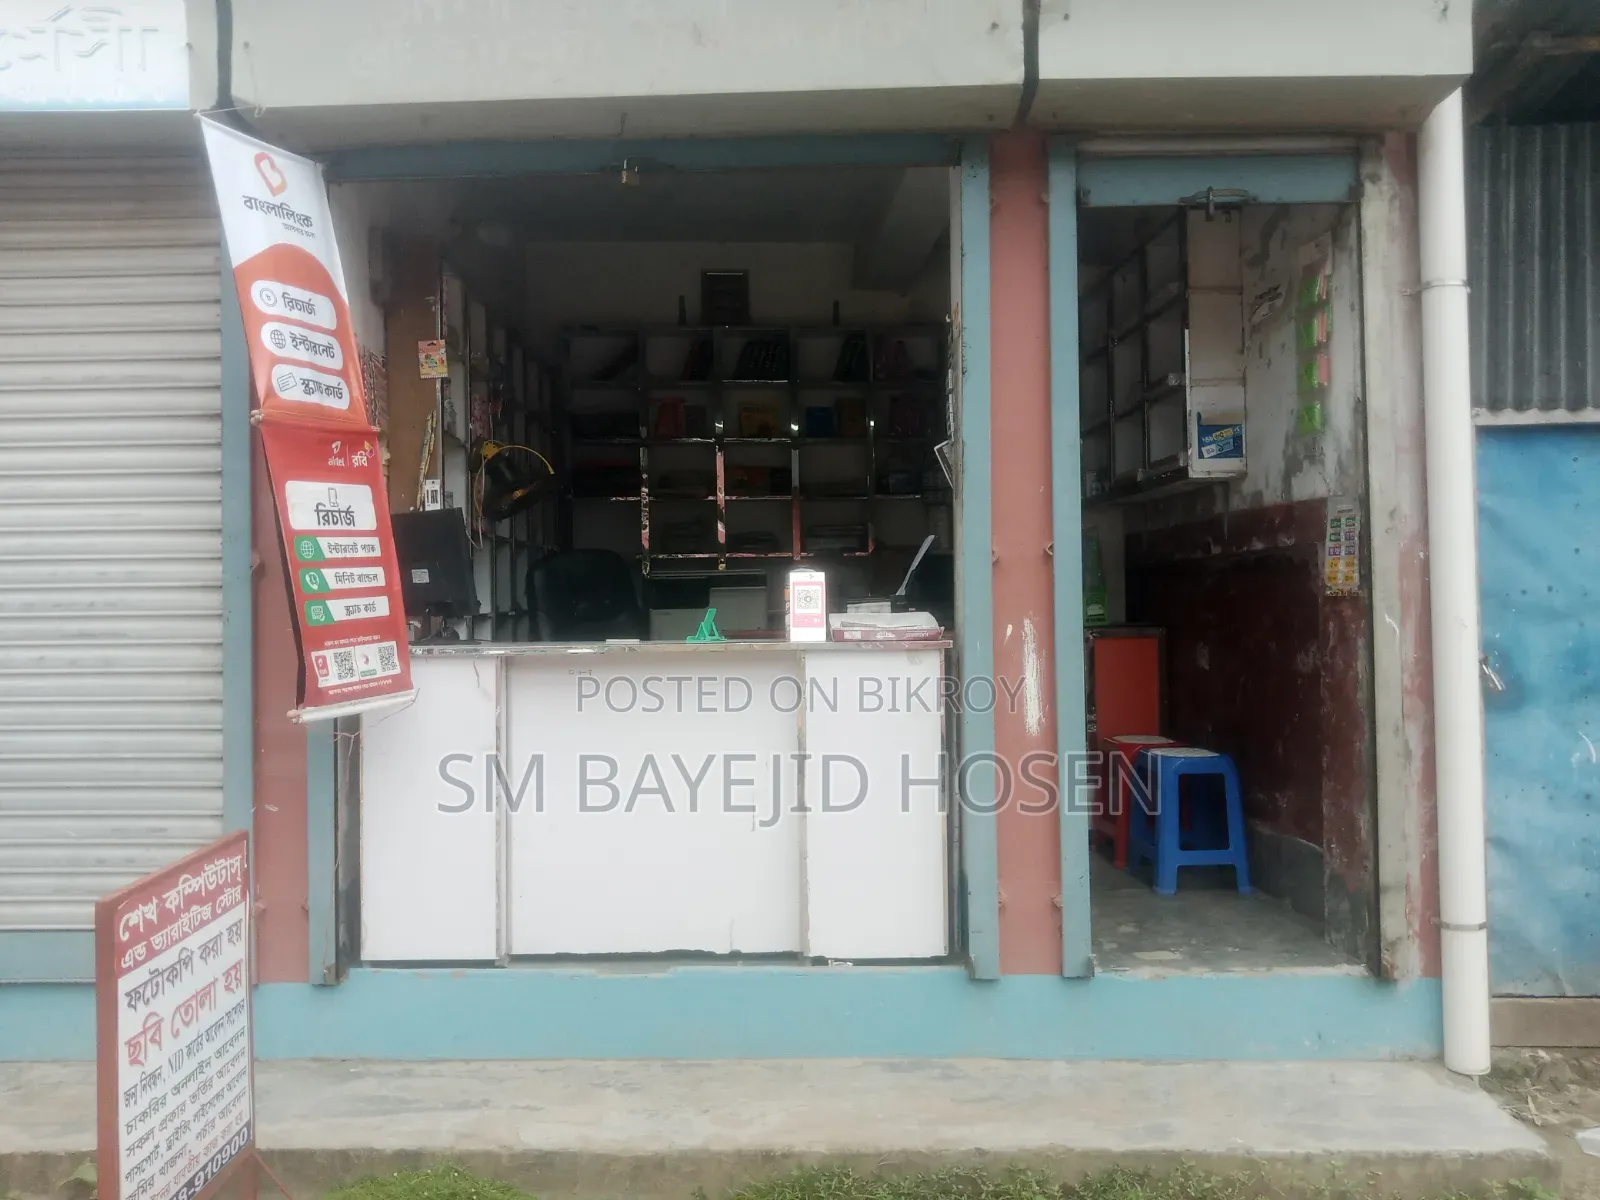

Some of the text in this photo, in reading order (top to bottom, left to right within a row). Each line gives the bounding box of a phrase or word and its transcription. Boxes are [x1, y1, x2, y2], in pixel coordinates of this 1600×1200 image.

[242, 194, 313, 228] বাংলালিংক
[282, 292, 316, 316] রিচার্জ
[289, 331, 335, 359] ইন্টারনেট
[324, 382, 343, 400] কার্ড
[351, 451, 368, 467] রবি
[314, 502, 356, 527] রিচার্জ
[328, 542, 359, 554] ইন্টারনেট
[334, 572, 355, 585] মিনিট
[363, 601, 377, 613] কার্ড
[216, 885, 242, 914] স্টোর
[120, 896, 158, 941] শেখ
[124, 918, 243, 1013] ফটোকপি করা হয়
[124, 958, 243, 1066] ছবি তোলা হয়
[168, 1049, 184, 1075] NID
[124, 1025, 246, 1136] চাকরির অনলাইন আবেদন
[125, 1126, 156, 1157] সকল
[158, 1100, 187, 1132] প্রকার
[216, 1046, 246, 1080] আবেদন
